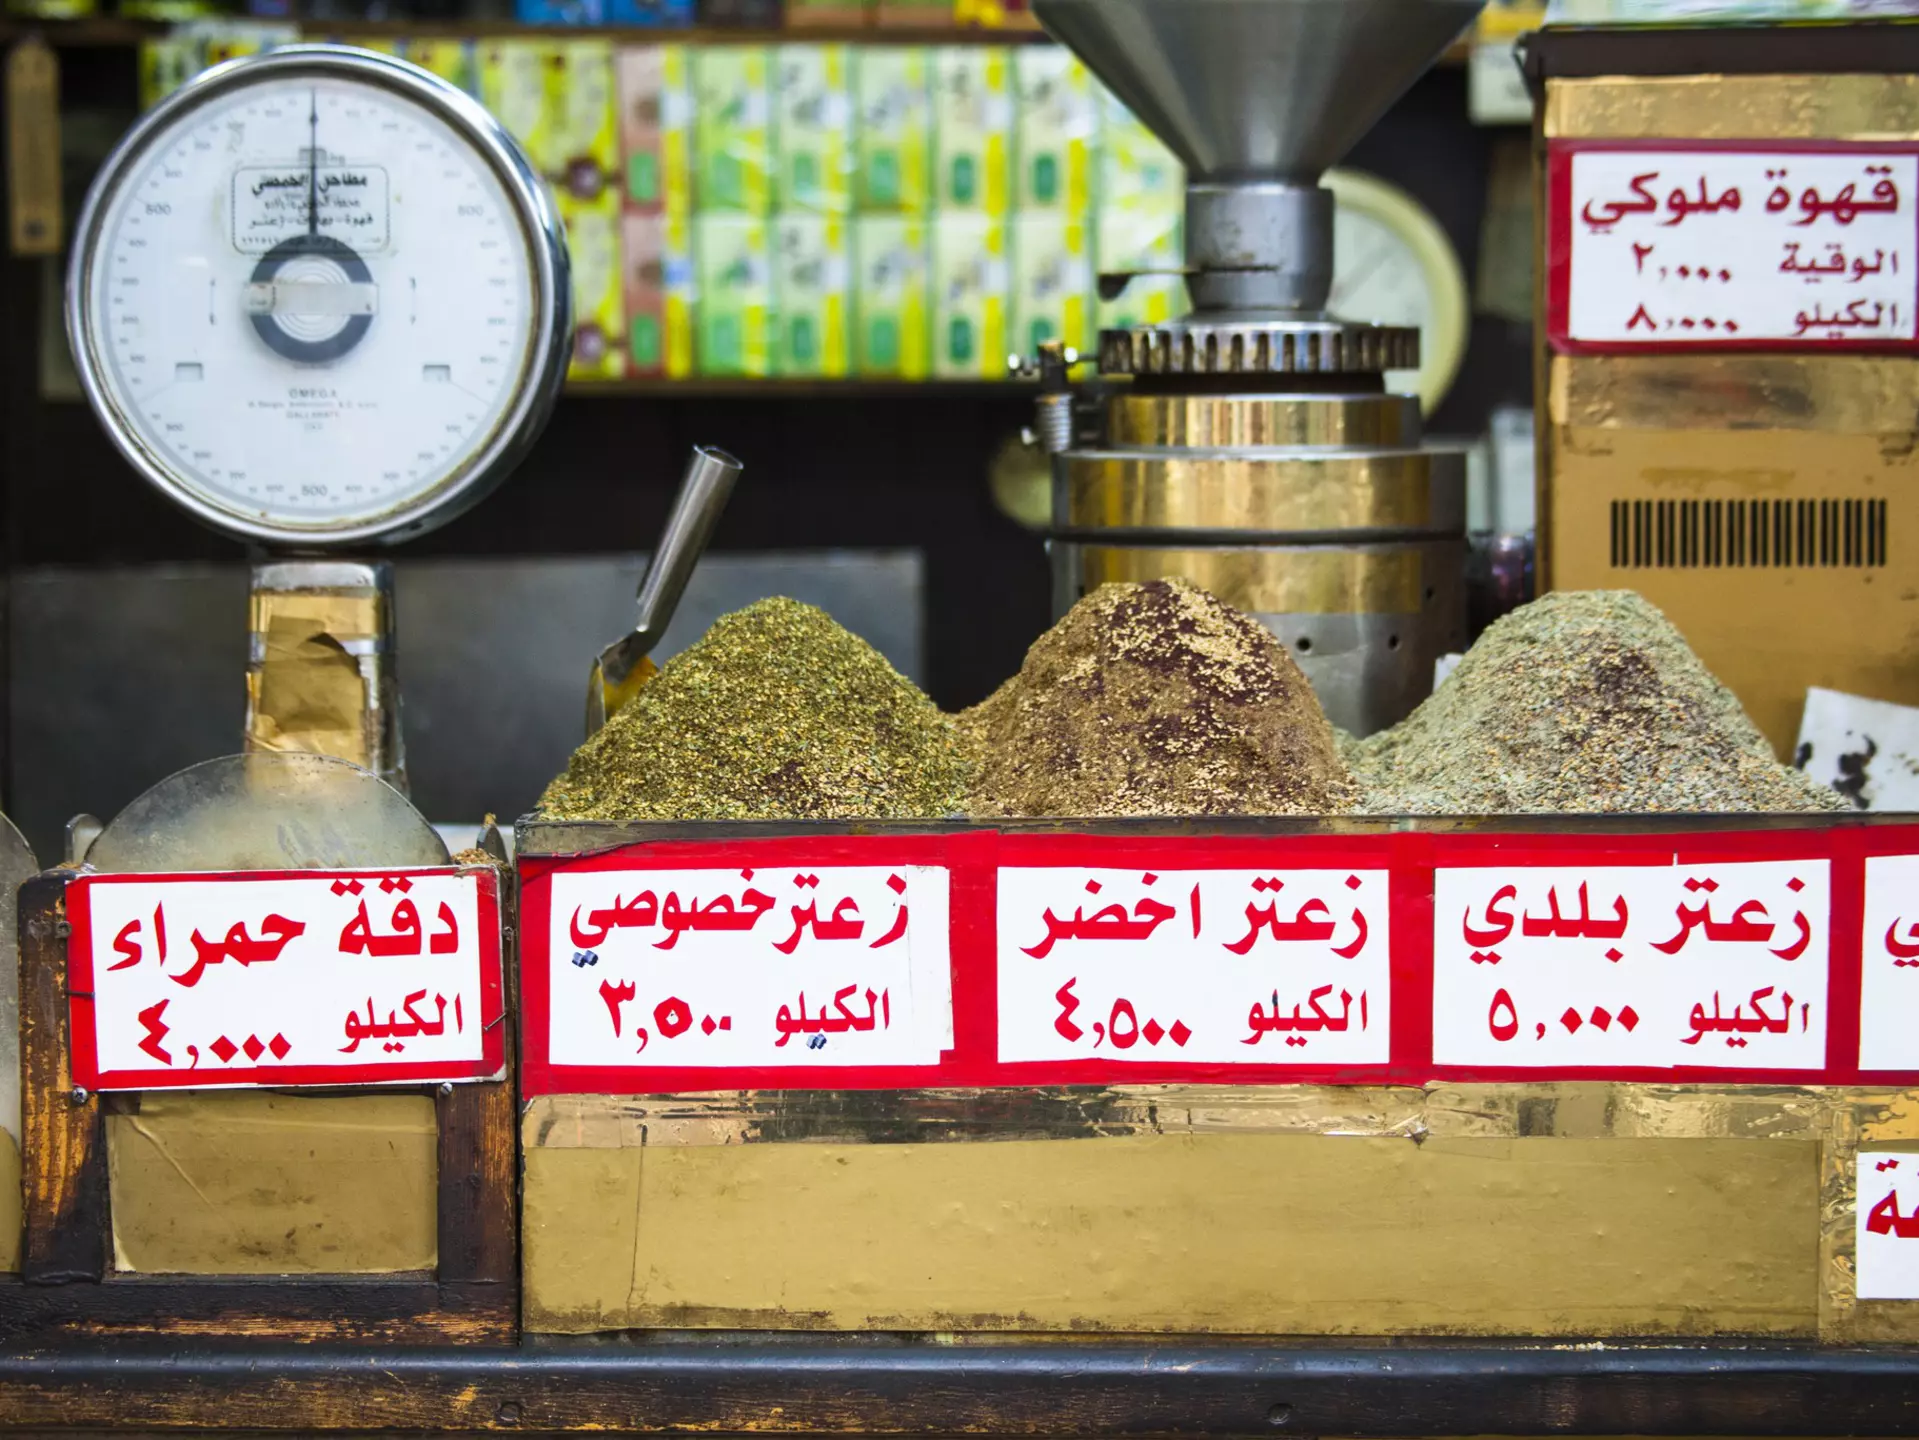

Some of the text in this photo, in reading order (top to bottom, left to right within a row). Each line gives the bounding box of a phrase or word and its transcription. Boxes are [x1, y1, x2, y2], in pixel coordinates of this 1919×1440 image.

[1581, 166, 1899, 234] قهوة ملوكي
[1779, 242, 1899, 283] الوقية
[1790, 300, 1899, 338] الكيلو
[107, 878, 460, 988] دقة حمراء
[569, 868, 909, 968] زعتر خصوصي
[1019, 872, 1369, 960] زعتر اخضر
[1462, 880, 1629, 966] بلدي
[1650, 877, 1811, 962] زعتر
[338, 989, 464, 1054] الكيلو
[774, 984, 891, 1050] الكيلو
[1240, 984, 1369, 1048] الكيلو
[1680, 986, 1810, 1049] الكيلو
